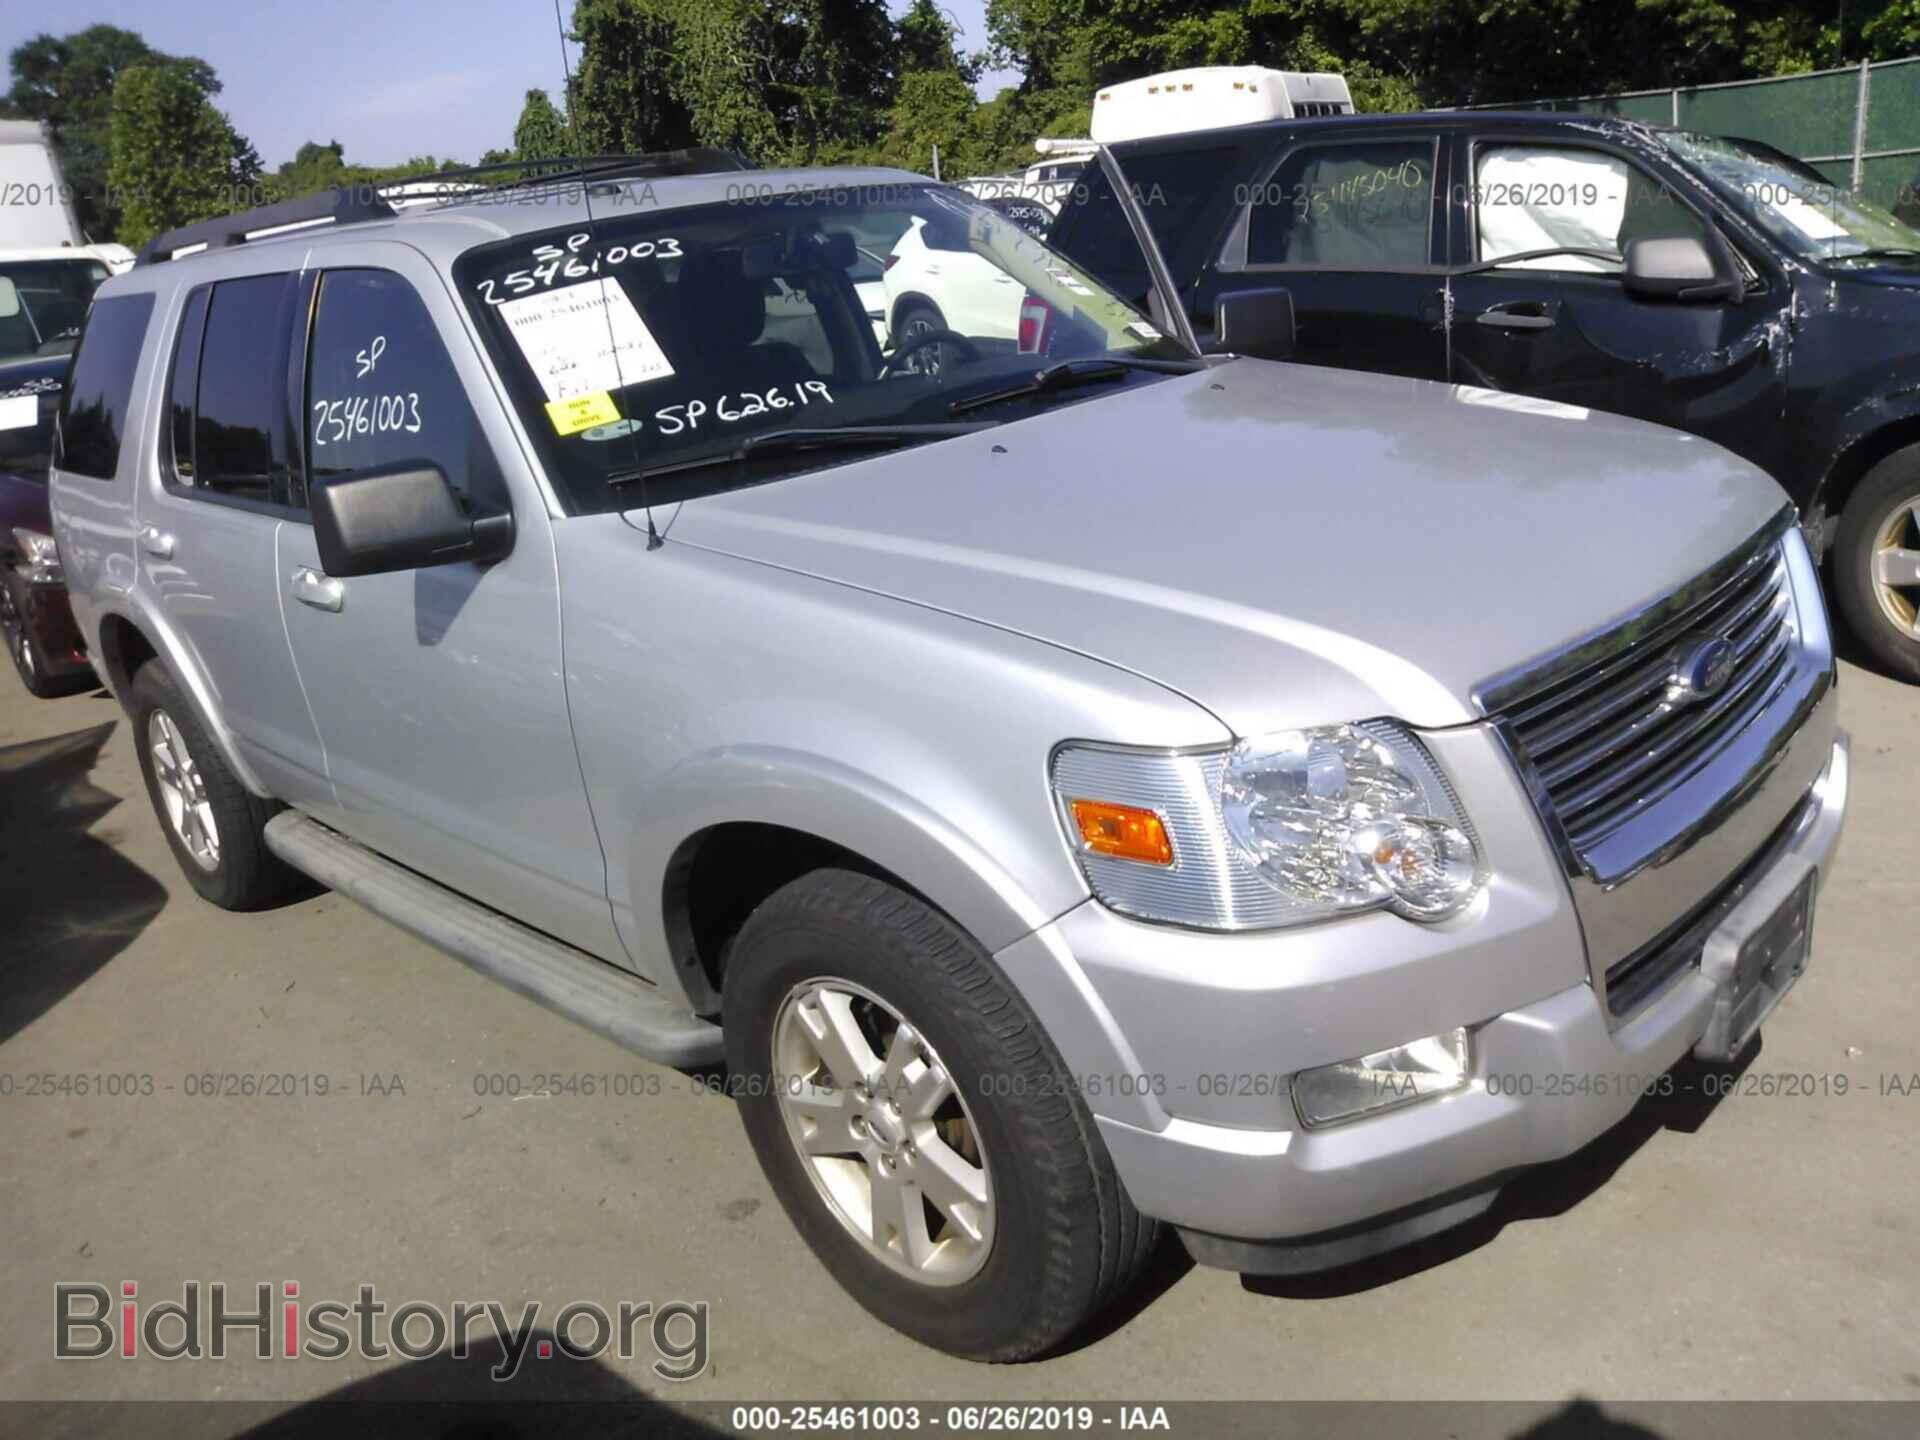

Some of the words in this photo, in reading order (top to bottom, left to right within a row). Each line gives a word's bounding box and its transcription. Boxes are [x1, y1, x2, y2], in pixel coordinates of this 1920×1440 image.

[477, 238, 684, 305] 25461003
[532, 233, 590, 262] SP
[356, 335, 386, 378] SP
[314, 393, 422, 445] 25461003
[655, 400, 707, 434] SP
[716, 381, 834, 422] 626.19
